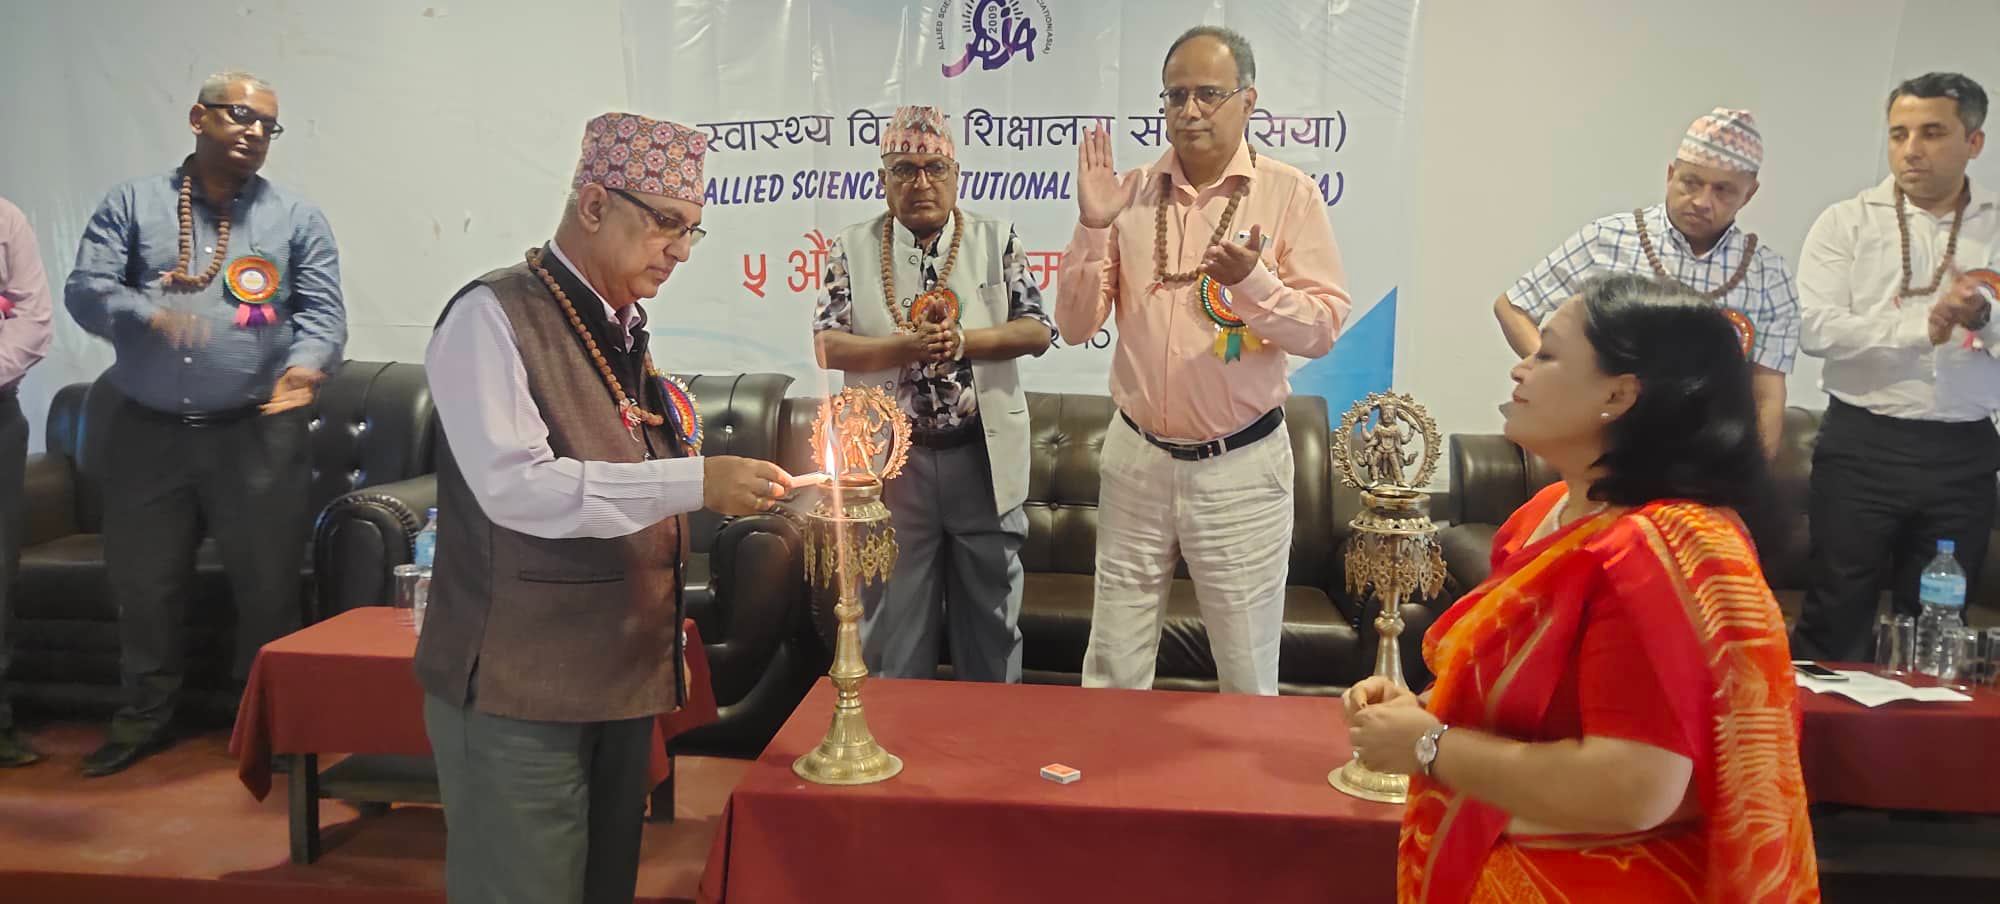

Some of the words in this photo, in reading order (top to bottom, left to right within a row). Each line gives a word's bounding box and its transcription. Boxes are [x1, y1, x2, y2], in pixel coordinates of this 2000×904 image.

[936, 20, 945, 50] ALLIED
[988, 5, 998, 34] 2009
[696, 115, 835, 152] स्वास्थ्य
[704, 173, 785, 206] ALLIED
[959, 170, 1071, 201] TUTIONAL
